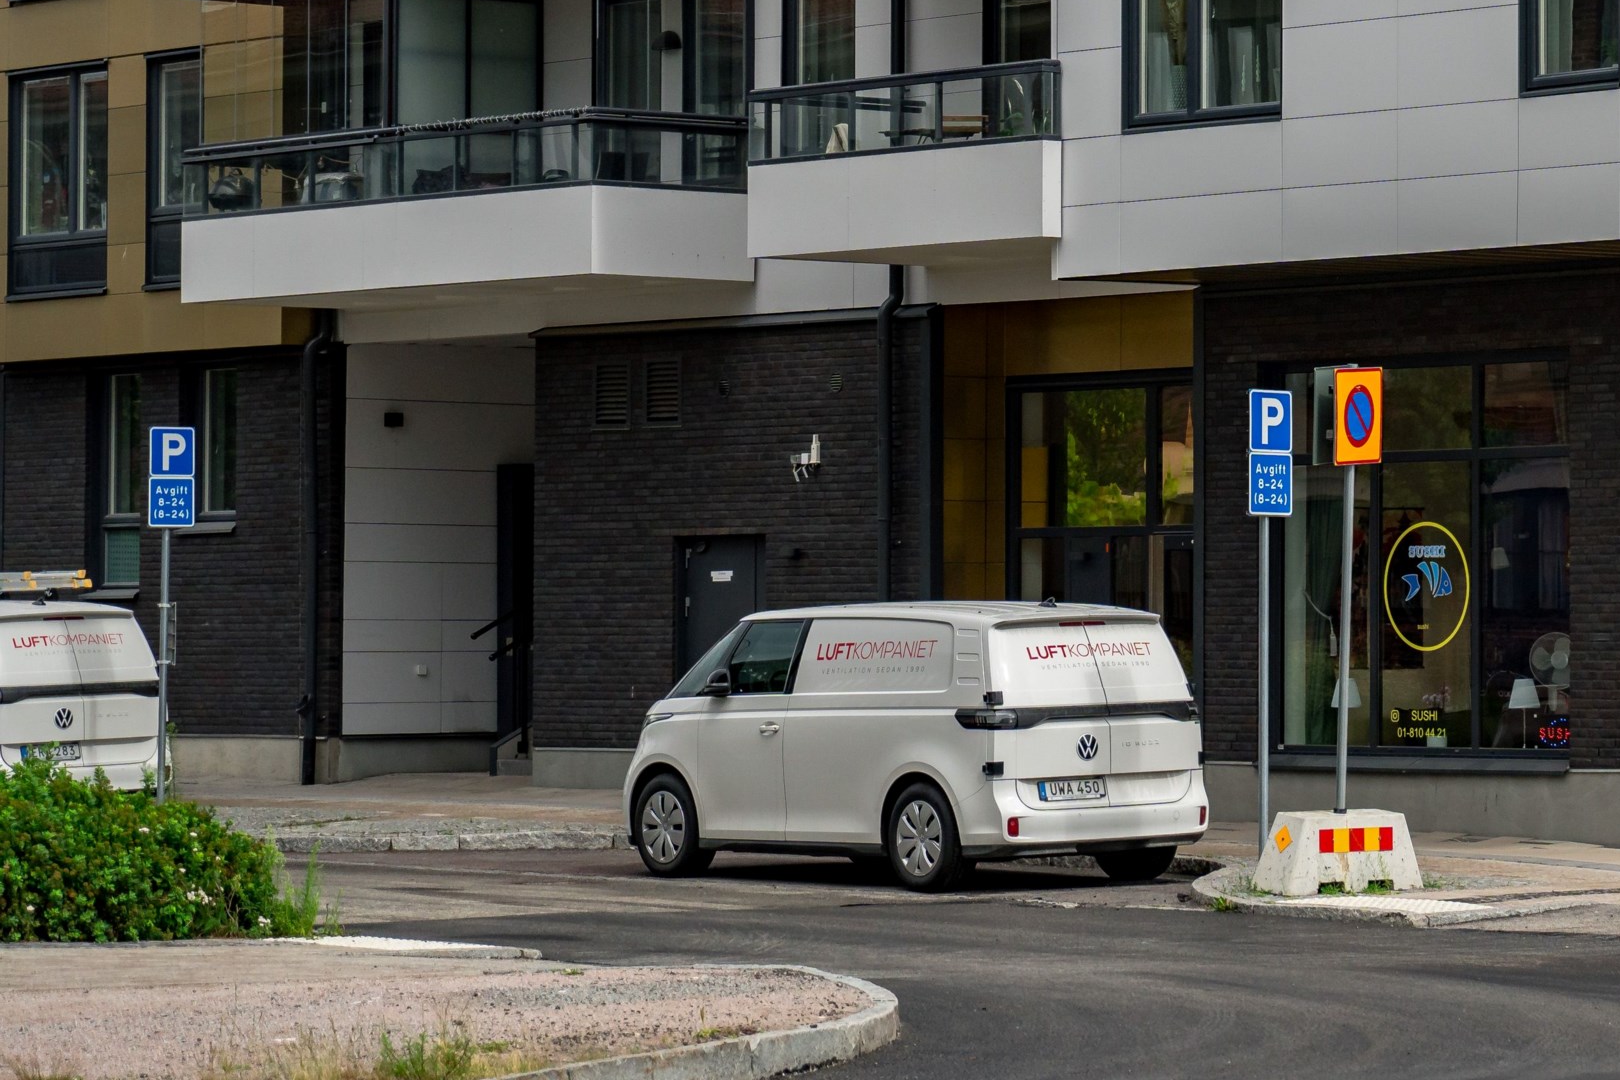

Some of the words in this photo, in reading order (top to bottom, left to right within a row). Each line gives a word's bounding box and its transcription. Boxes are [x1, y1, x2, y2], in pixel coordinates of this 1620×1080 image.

[1261, 397, 1285, 445] P
[162, 432, 187, 471] P
[1255, 463, 1286, 476] Avgift
[1258, 478, 1284, 490] 8-24
[155, 485, 188, 496] Avgift
[158, 497, 185, 507] 8-24
[1253, 492, 1288, 506] (8-24)
[153, 508, 190, 519] (8-24)
[1408, 545, 1446, 558] SUSHI
[12, 633, 124, 649] LUFTKOMPANIET
[816, 639, 938, 661] LUFTKOMPANIET
[1026, 641, 1151, 660] LUFTKOMPANIET
[822, 666, 872, 675] VENTILATION
[905, 665, 925, 673] 1990
[1041, 662, 1097, 671] VENTILATION
[1411, 710, 1438, 721] SUSHI
[1397, 727, 1424, 738] 01-810
[54, 745, 76, 756] 283
[1050, 782, 1074, 796] UWA
[1077, 780, 1100, 794] 450
